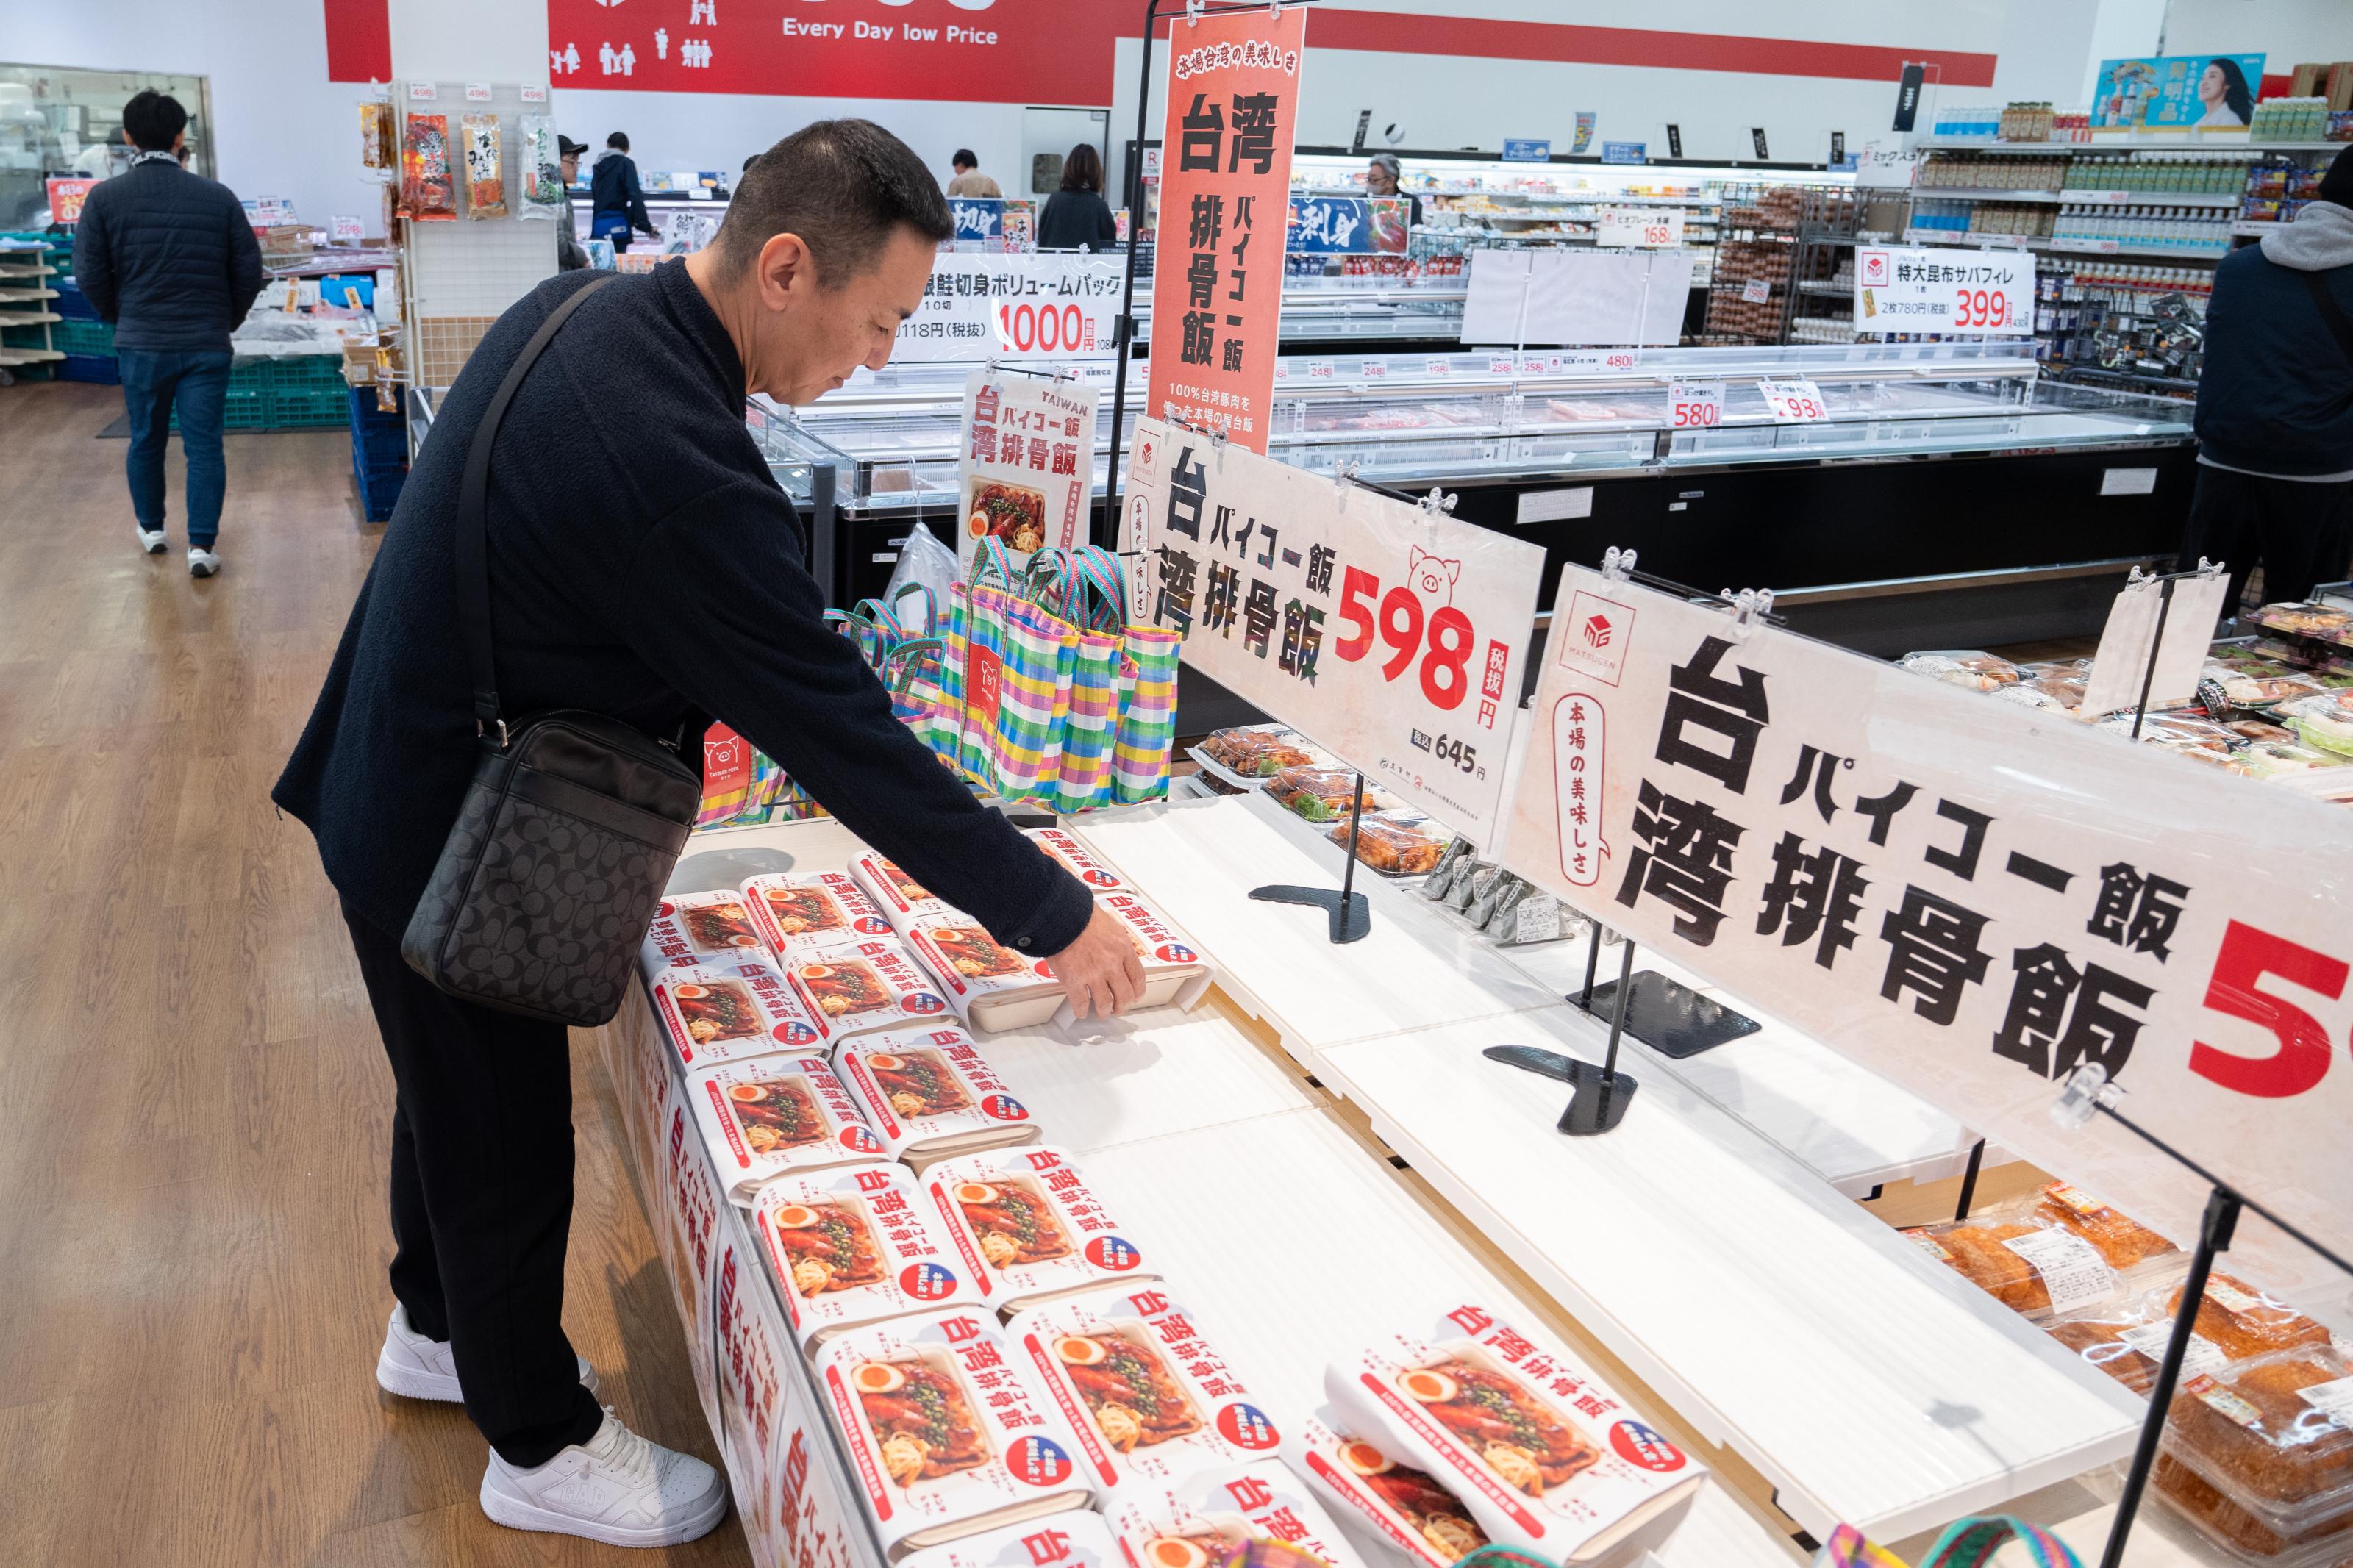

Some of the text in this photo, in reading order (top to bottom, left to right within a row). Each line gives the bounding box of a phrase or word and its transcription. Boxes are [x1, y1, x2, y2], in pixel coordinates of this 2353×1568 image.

[782, 18, 998, 45] Every Day low Price
[1177, 41, 1296, 77] 本場台湾の美味しさ
[1180, 92, 1280, 174] 台湾
[1298, 203, 1359, 247] 刺身
[1644, 227, 1667, 243] 168
[1181, 194, 1224, 368] 排骨飯
[1223, 196, 1256, 373] パイコー飯
[1897, 265, 2013, 284] 特大昆布サバフィレ
[999, 304, 1083, 352] 1000
[1954, 290, 2006, 327] 399
[896, 323, 987, 339] 118円（税抜）
[1311, 368, 1329, 376] 248
[1364, 367, 1382, 376] 248
[1607, 356, 1628, 367] 480
[1043, 391, 1088, 416] TAIWAN
[1170, 383, 1250, 412] 100%台湾豚肉を
[1674, 404, 1713, 426] 580
[971, 385, 1000, 463] 台湾
[1002, 407, 1081, 438] パイコー飯
[1001, 433, 1078, 476] 排骨飯
[1154, 445, 1207, 641] 台湾
[1210, 504, 1337, 598] パイコー飯
[1203, 559, 1327, 688] 排骨飯
[1335, 565, 1507, 730] 598 税抜 円
[1568, 646, 1615, 670] MATSUGEN
[709, 770, 727, 778] TAIWAN
[1413, 730, 1486, 781] 税込 645 円
[1568, 702, 1587, 875] 本場の美味しさ
[1615, 635, 1771, 947] 台湾
[1779, 743, 2194, 965] パイコー飯
[1755, 829, 2160, 1092] 排骨飯
[2188, 918, 2353, 1099] 5
